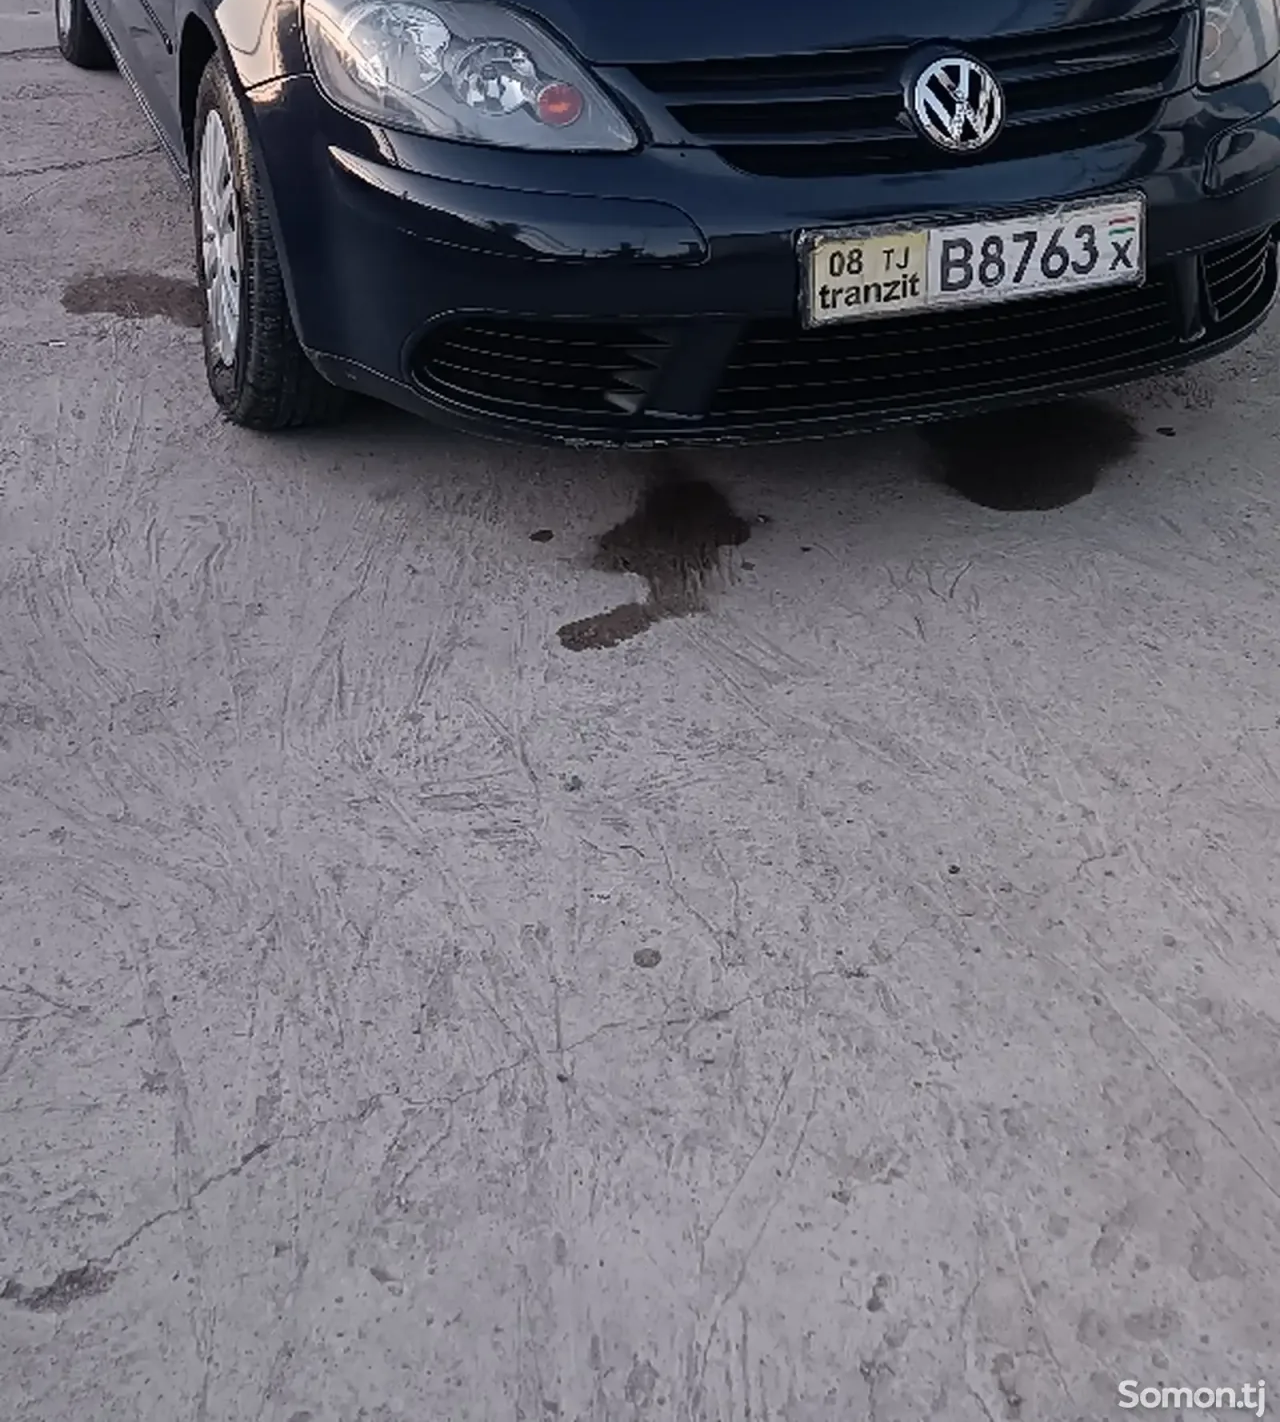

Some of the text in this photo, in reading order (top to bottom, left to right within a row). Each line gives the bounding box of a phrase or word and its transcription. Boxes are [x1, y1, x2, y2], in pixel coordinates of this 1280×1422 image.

[829, 246, 910, 277] 08 TJ
[939, 224, 1099, 293] B8763
[818, 272, 920, 310] tranzit
